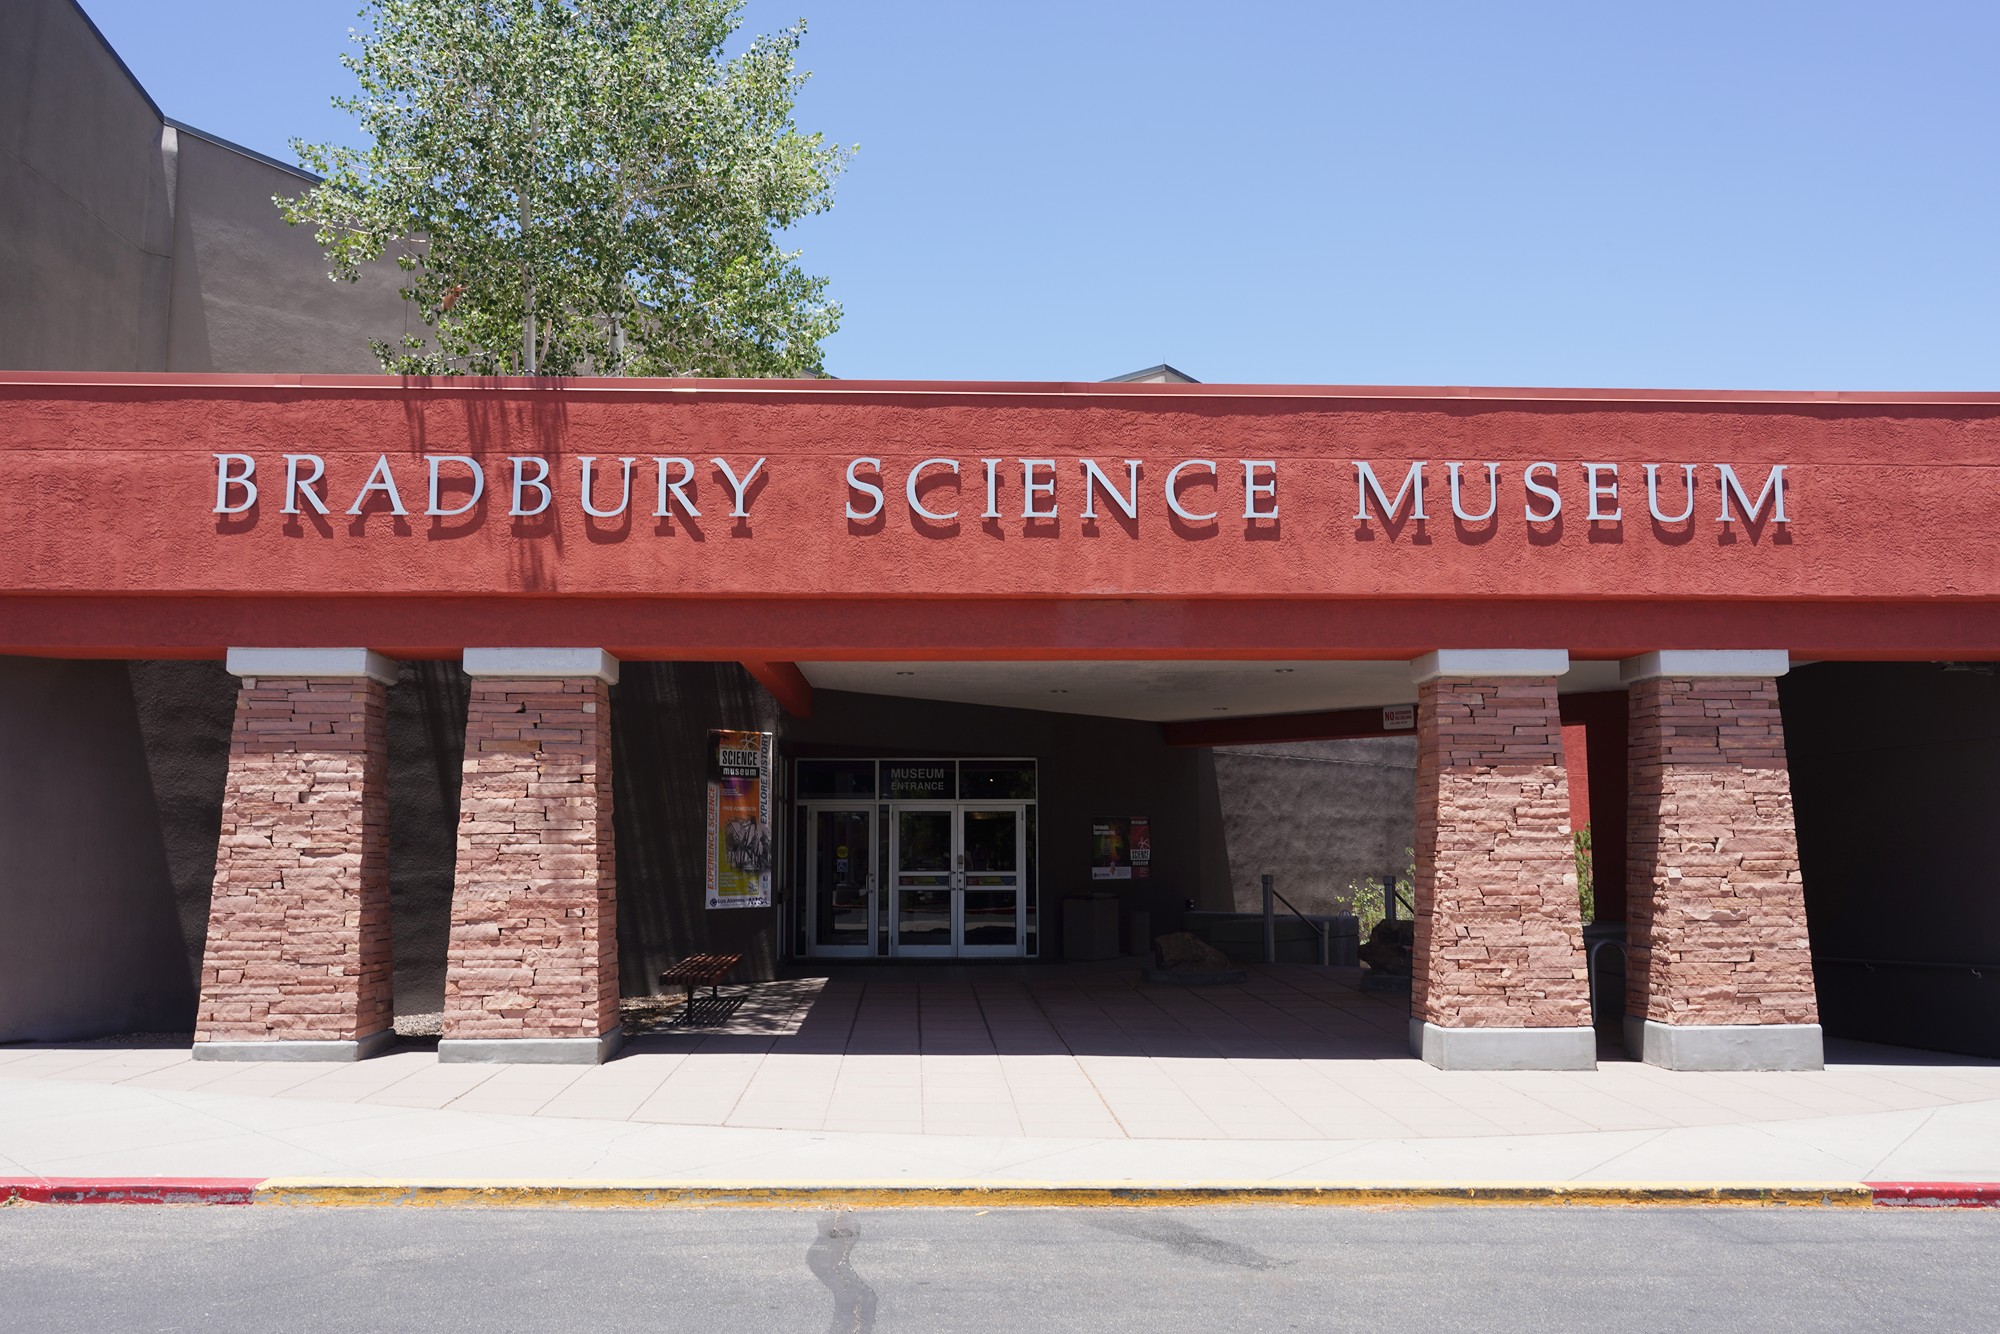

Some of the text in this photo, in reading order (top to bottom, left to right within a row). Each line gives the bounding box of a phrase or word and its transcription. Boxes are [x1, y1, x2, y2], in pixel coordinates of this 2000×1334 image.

[212, 453, 1790, 525] BRADBURY SCIENCE MUSEUM
[1384, 711, 1395, 722] NO
[722, 750, 758, 766] SCIENCE
[723, 767, 757, 776] museum
[890, 768, 945, 779] MUSEUM
[760, 733, 769, 825] EXPLORE HISTORY
[890, 781, 945, 791] ENTRANCE
[707, 785, 716, 890] EXPERIENCE SCIENCE
